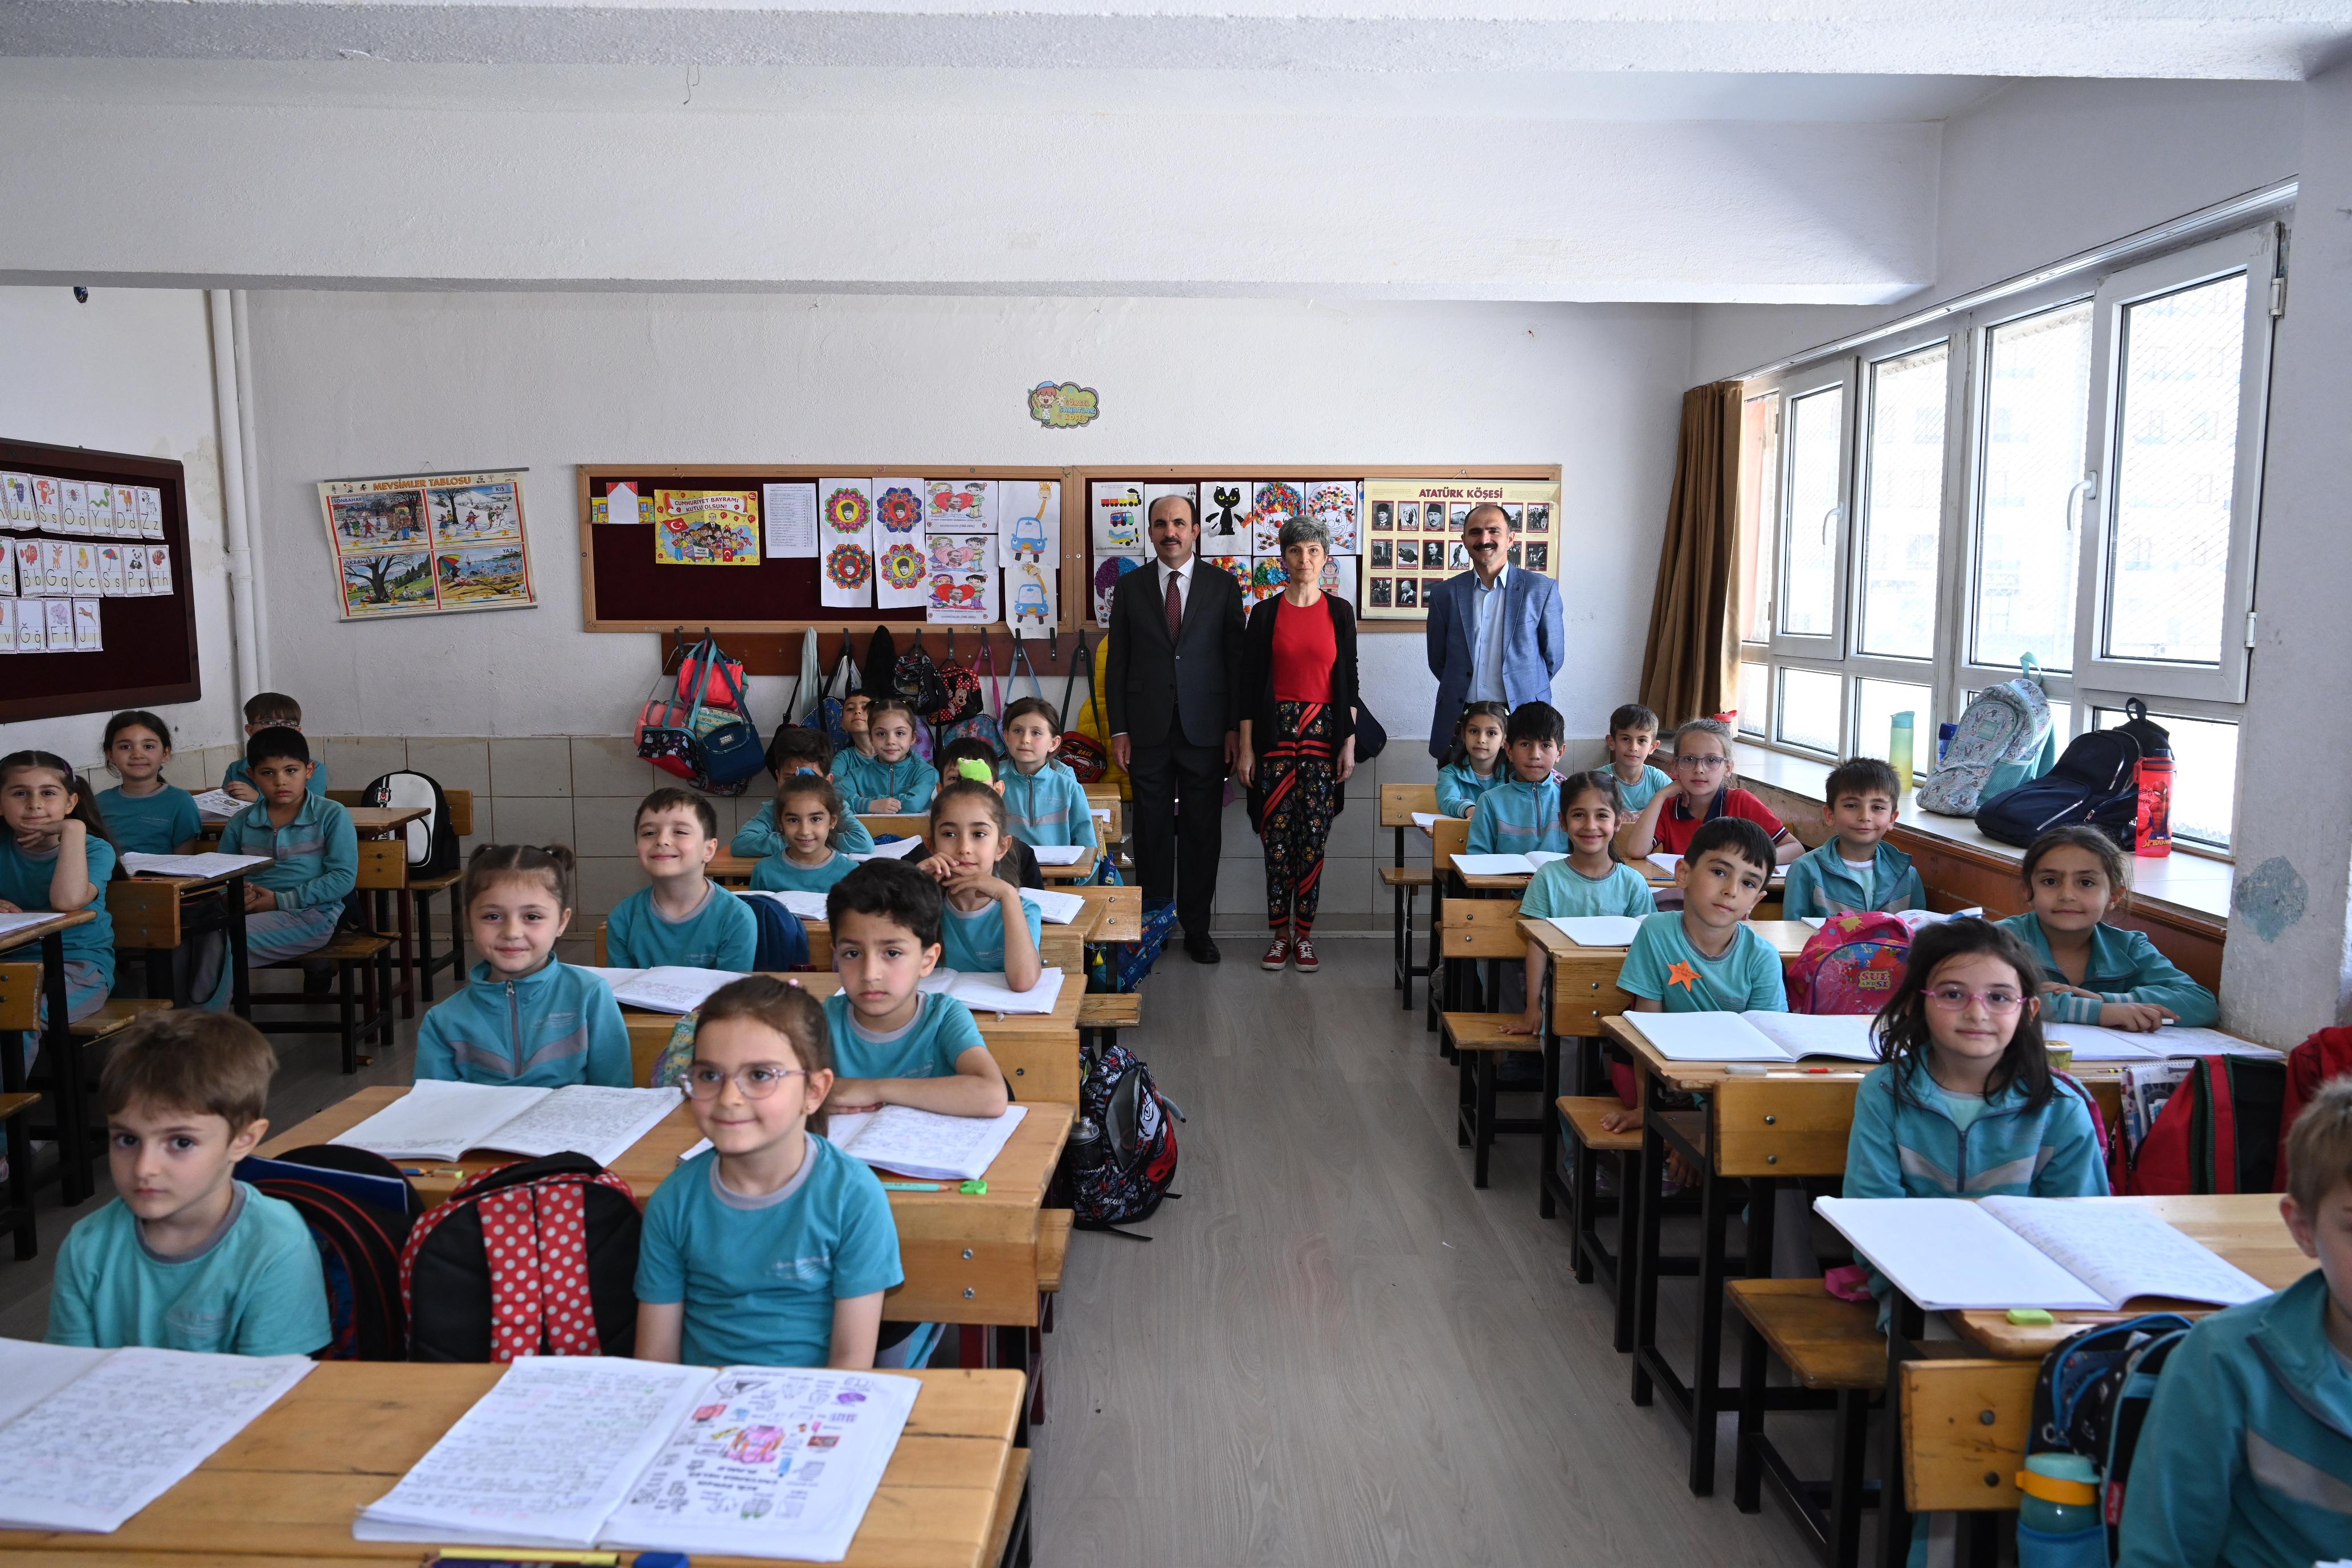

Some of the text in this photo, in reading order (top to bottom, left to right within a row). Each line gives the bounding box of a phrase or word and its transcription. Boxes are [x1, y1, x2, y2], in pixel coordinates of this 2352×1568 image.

[373, 476, 471, 491] MEVSİMLER TABLOSU
[1419, 487, 1463, 498] ATATÜRK
[1467, 487, 1502, 500] KÖŞESİ
[39, 505, 46, 522] S
[64, 504, 85, 525] Ö ö
[91, 510, 111, 534] Y y
[117, 512, 136, 529] D d
[141, 513, 158, 530] Z z
[23, 569, 40, 587] B b
[46, 569, 68, 594] G g
[128, 571, 145, 593] P p
[152, 571, 168, 586] H h
[20, 622, 41, 650] Ğ ğ
[51, 626, 68, 643] F f
[80, 626, 86, 642] J
